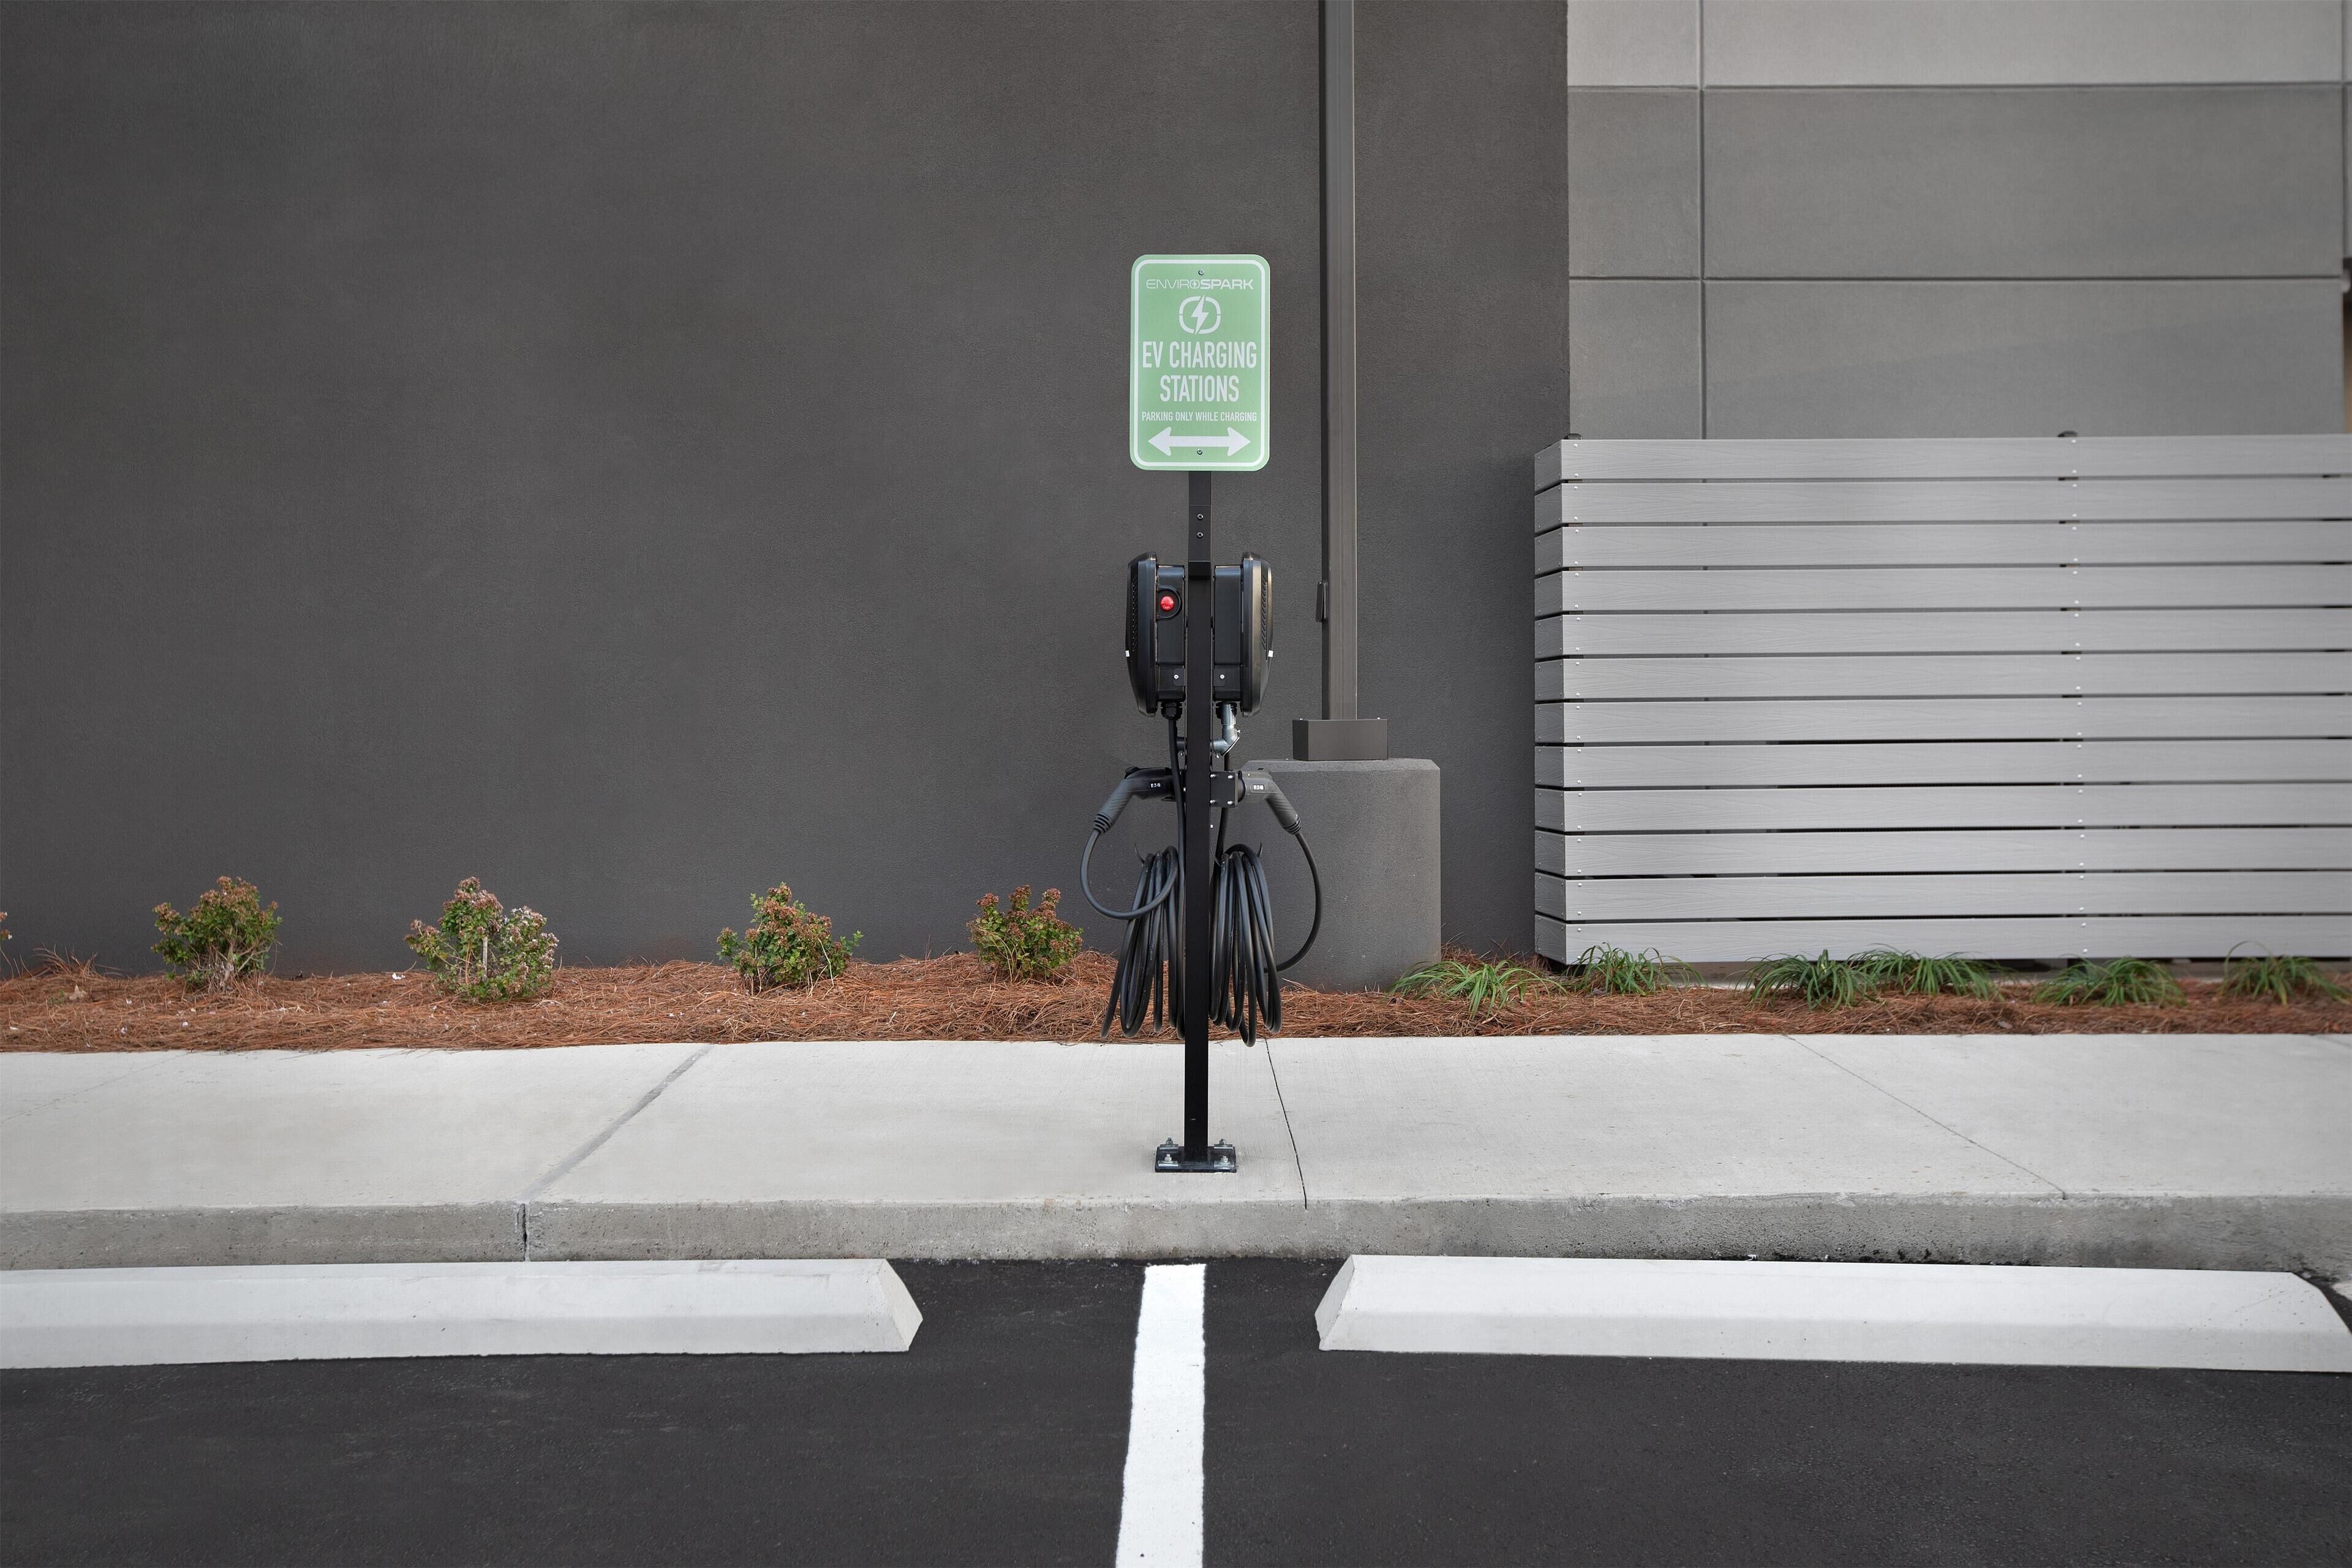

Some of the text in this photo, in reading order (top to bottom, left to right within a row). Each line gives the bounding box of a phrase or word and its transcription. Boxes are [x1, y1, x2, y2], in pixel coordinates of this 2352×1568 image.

[1146, 279, 1254, 290] ENVIROSPARK
[1142, 341, 1257, 369] EV CHARGING
[1159, 375, 1240, 402] STATIONS
[1142, 412, 1257, 422] PARKING ONLY WHILE CHARGING
